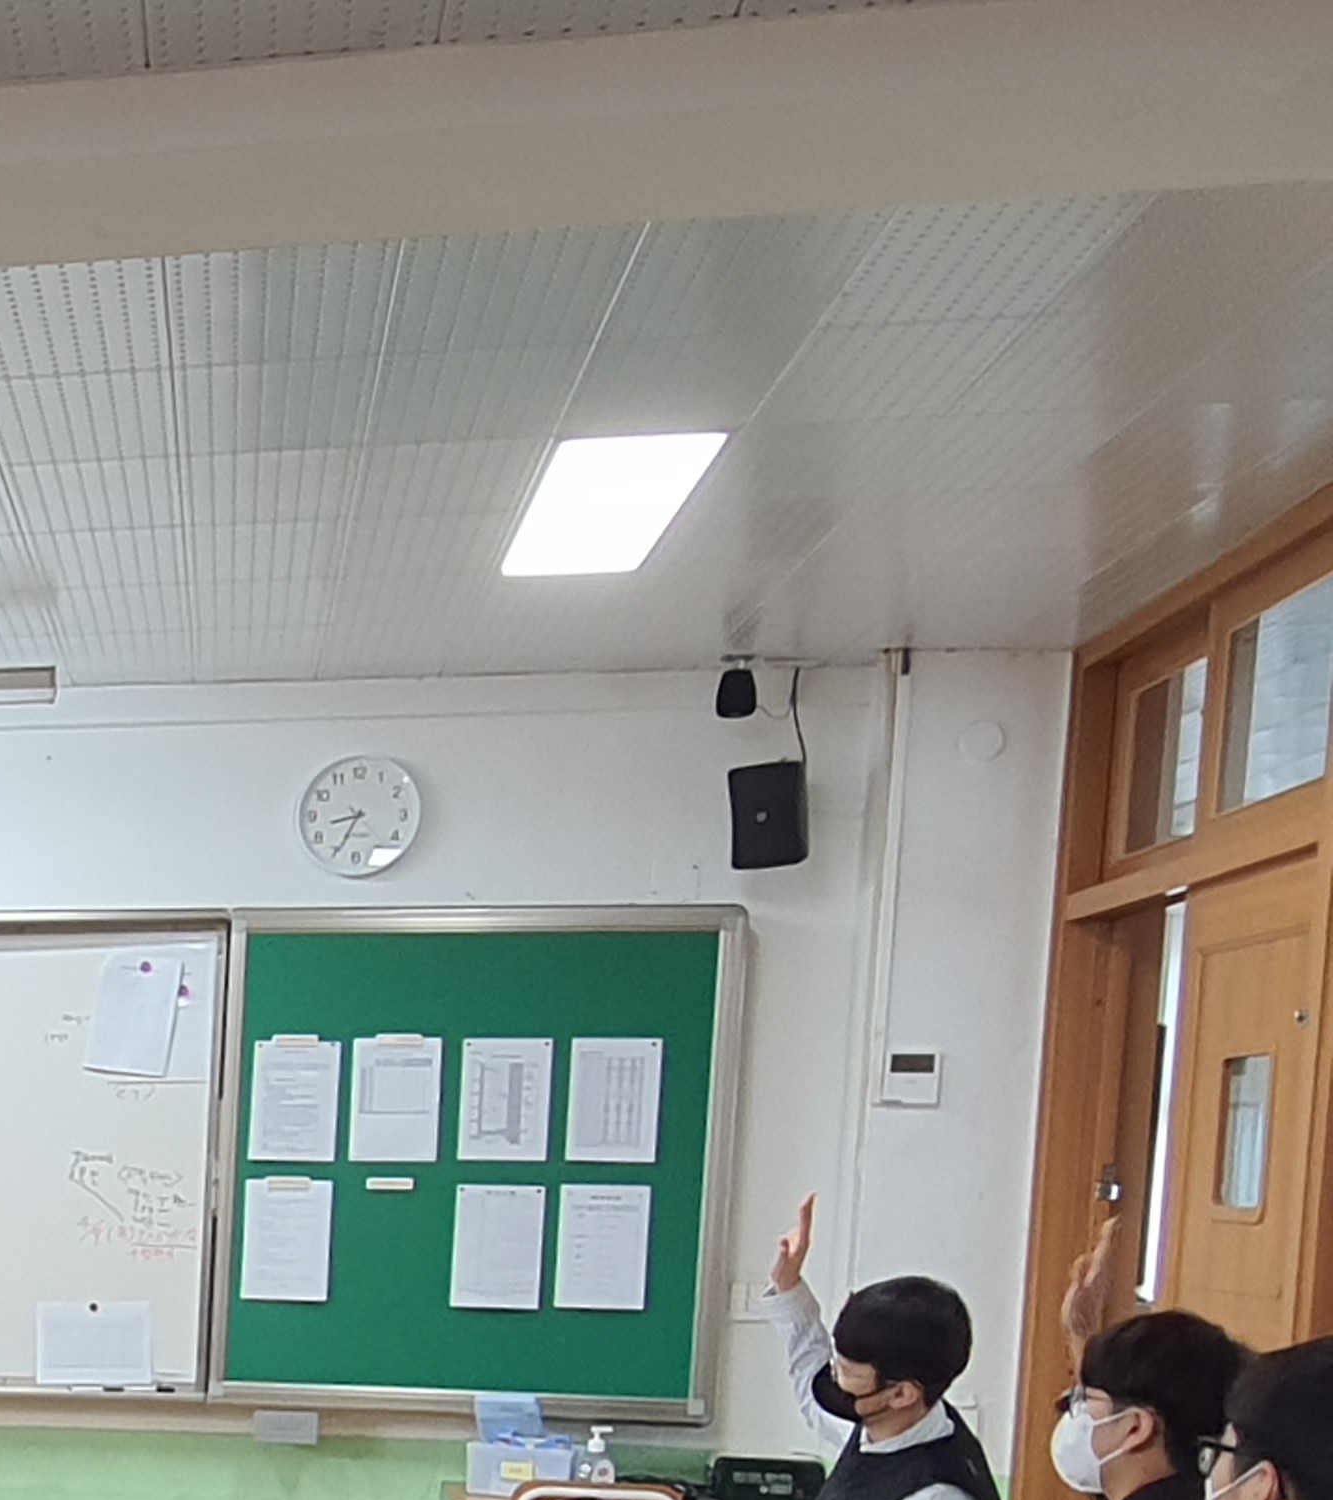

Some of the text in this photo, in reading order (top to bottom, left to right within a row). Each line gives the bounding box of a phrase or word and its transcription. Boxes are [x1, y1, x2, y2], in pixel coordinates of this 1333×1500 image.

[333, 772, 345, 786] 11
[353, 766, 368, 780] 12
[316, 789, 330, 802] 10
[392, 785, 403, 799] 2
[308, 809, 318, 823] 9
[399, 808, 408, 822] 3
[390, 829, 400, 842] 4
